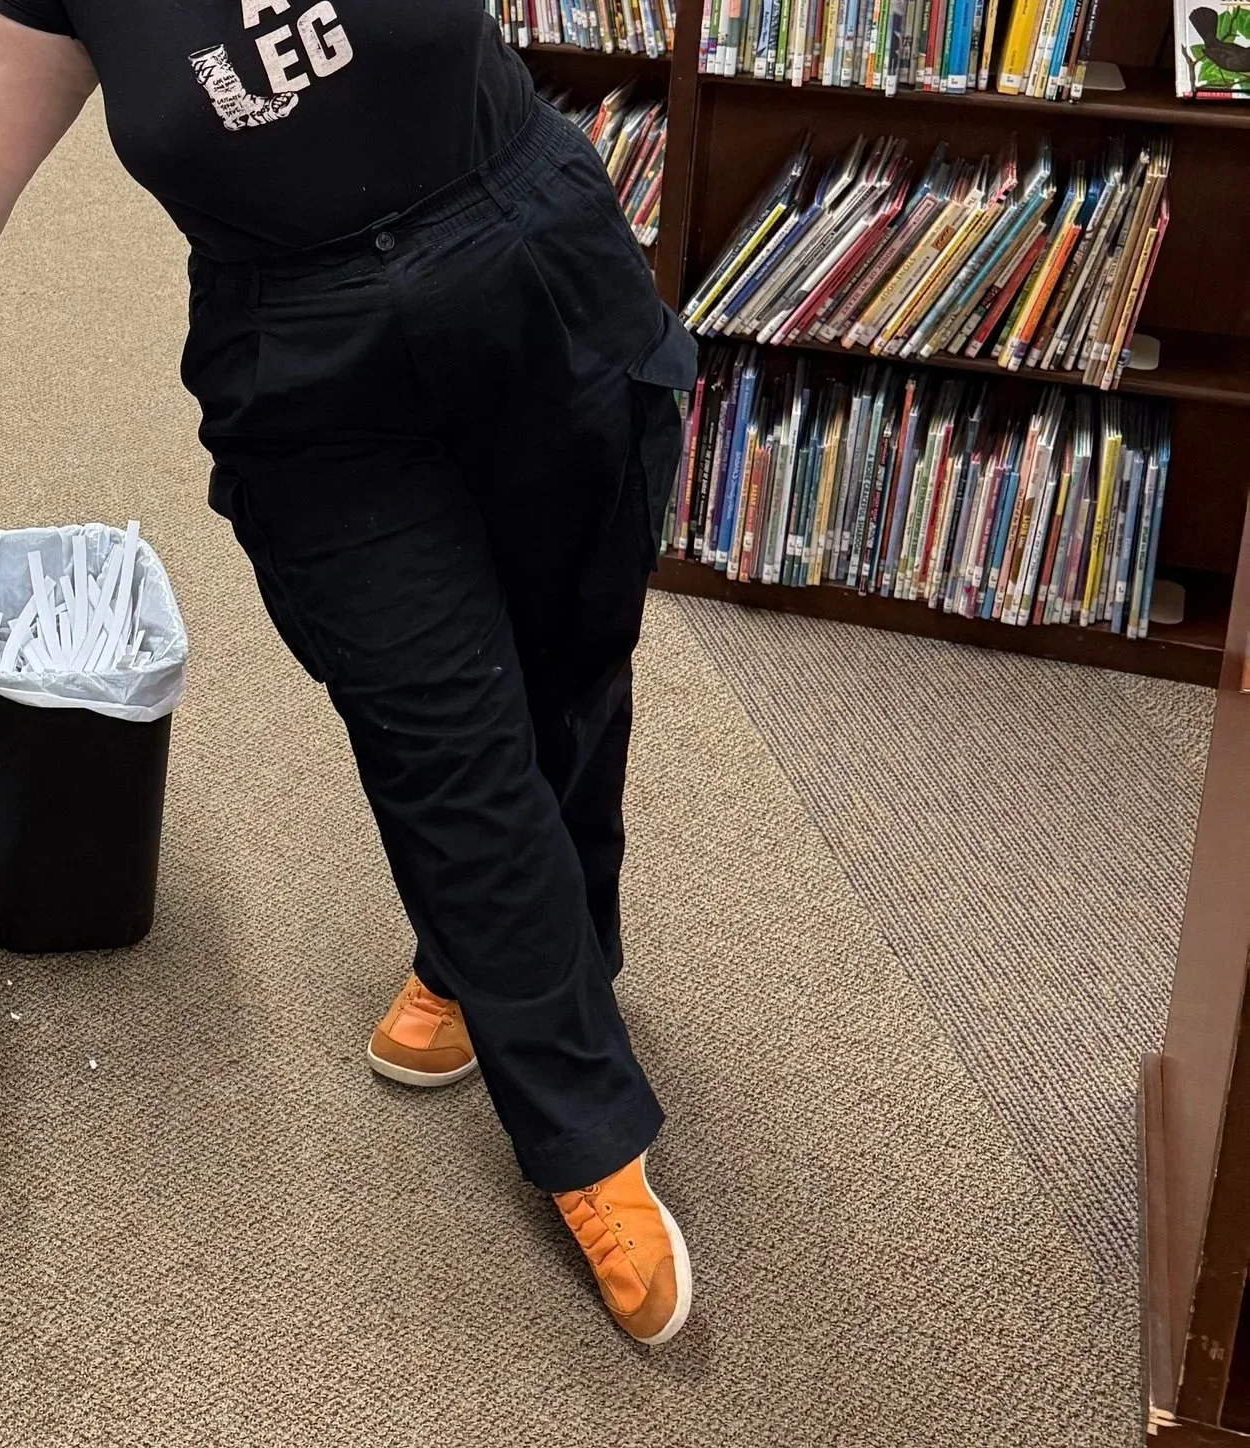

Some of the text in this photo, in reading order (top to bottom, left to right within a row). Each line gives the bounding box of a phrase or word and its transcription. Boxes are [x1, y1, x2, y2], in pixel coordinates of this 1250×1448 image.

[877, 280, 898, 302] SOUP
[864, 461, 874, 480] MORE
[858, 481, 870, 518] GRACEFUL
[1018, 513, 1031, 536] LION
